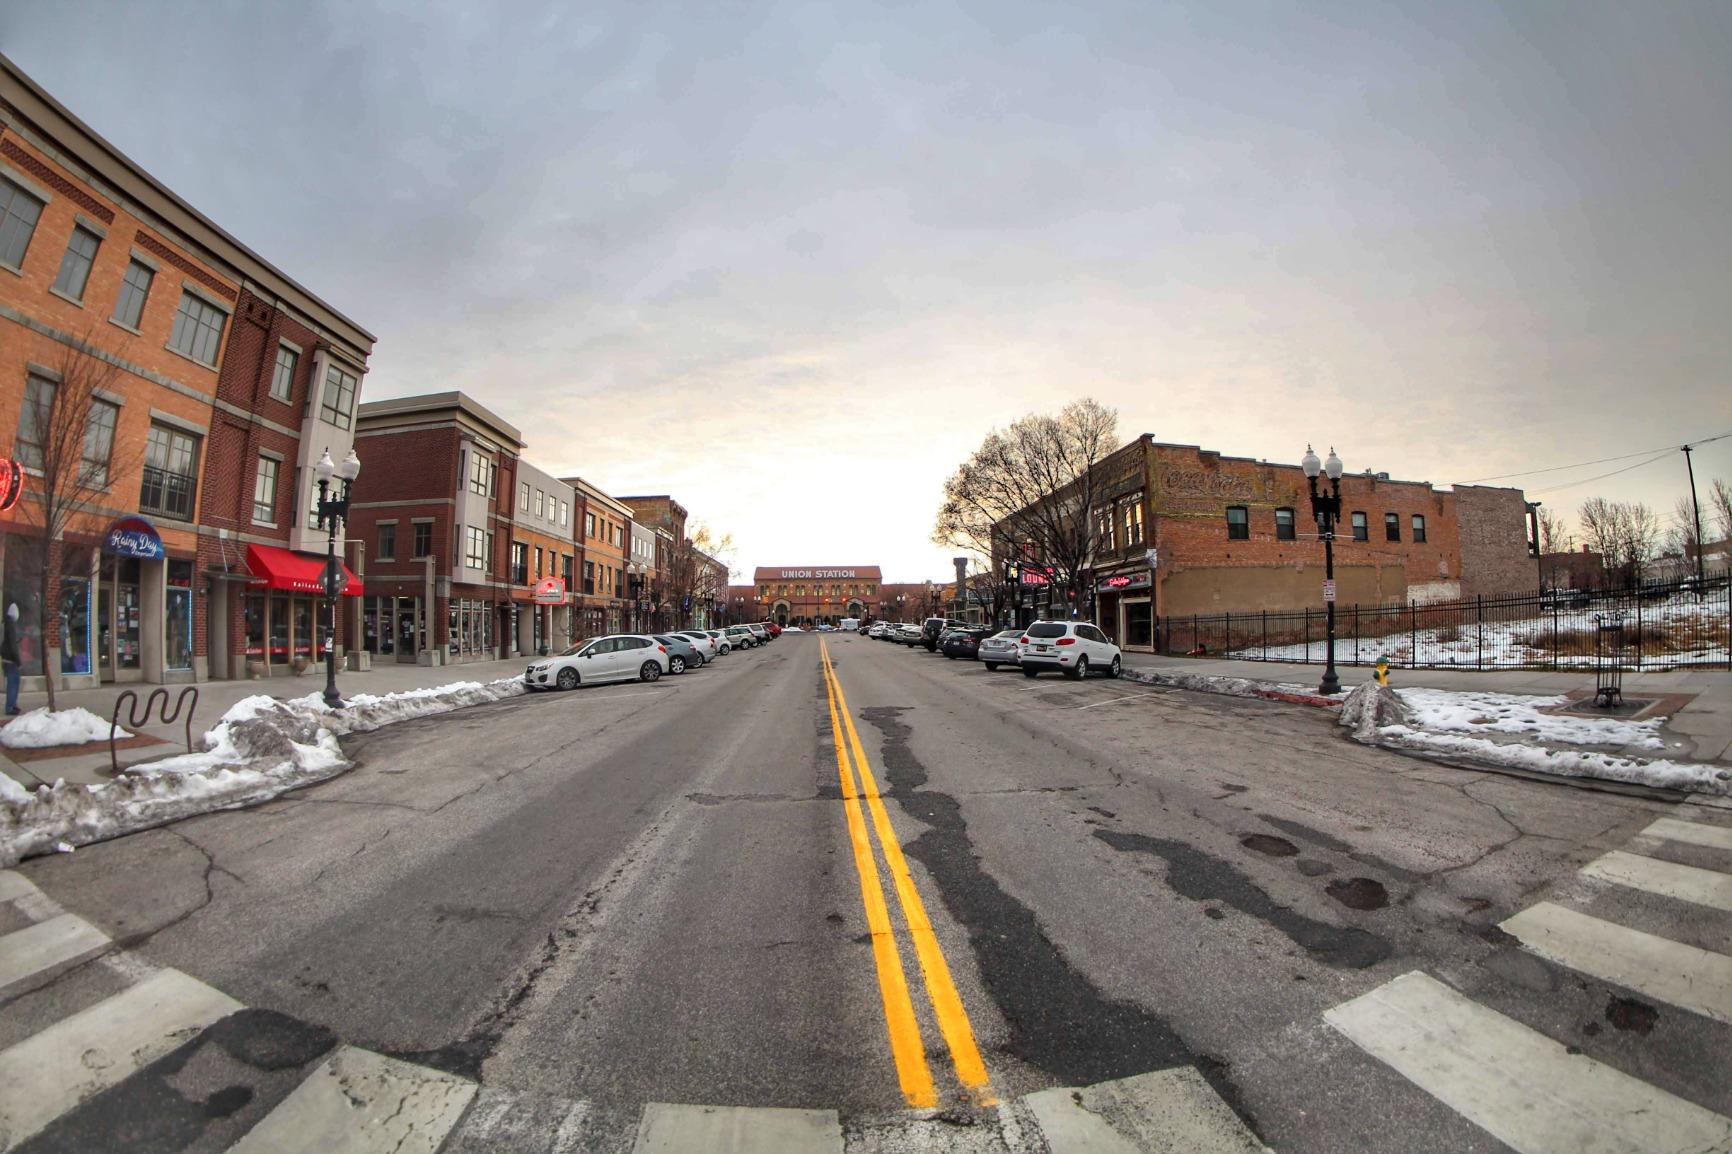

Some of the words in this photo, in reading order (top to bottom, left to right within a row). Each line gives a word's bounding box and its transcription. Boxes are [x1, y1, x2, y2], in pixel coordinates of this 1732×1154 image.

[111, 529, 137, 554] Rainy
[139, 533, 158, 557] Day
[781, 570, 812, 579] UNION
[815, 569, 856, 578] STATION
[1022, 573, 1054, 584] LOUN
